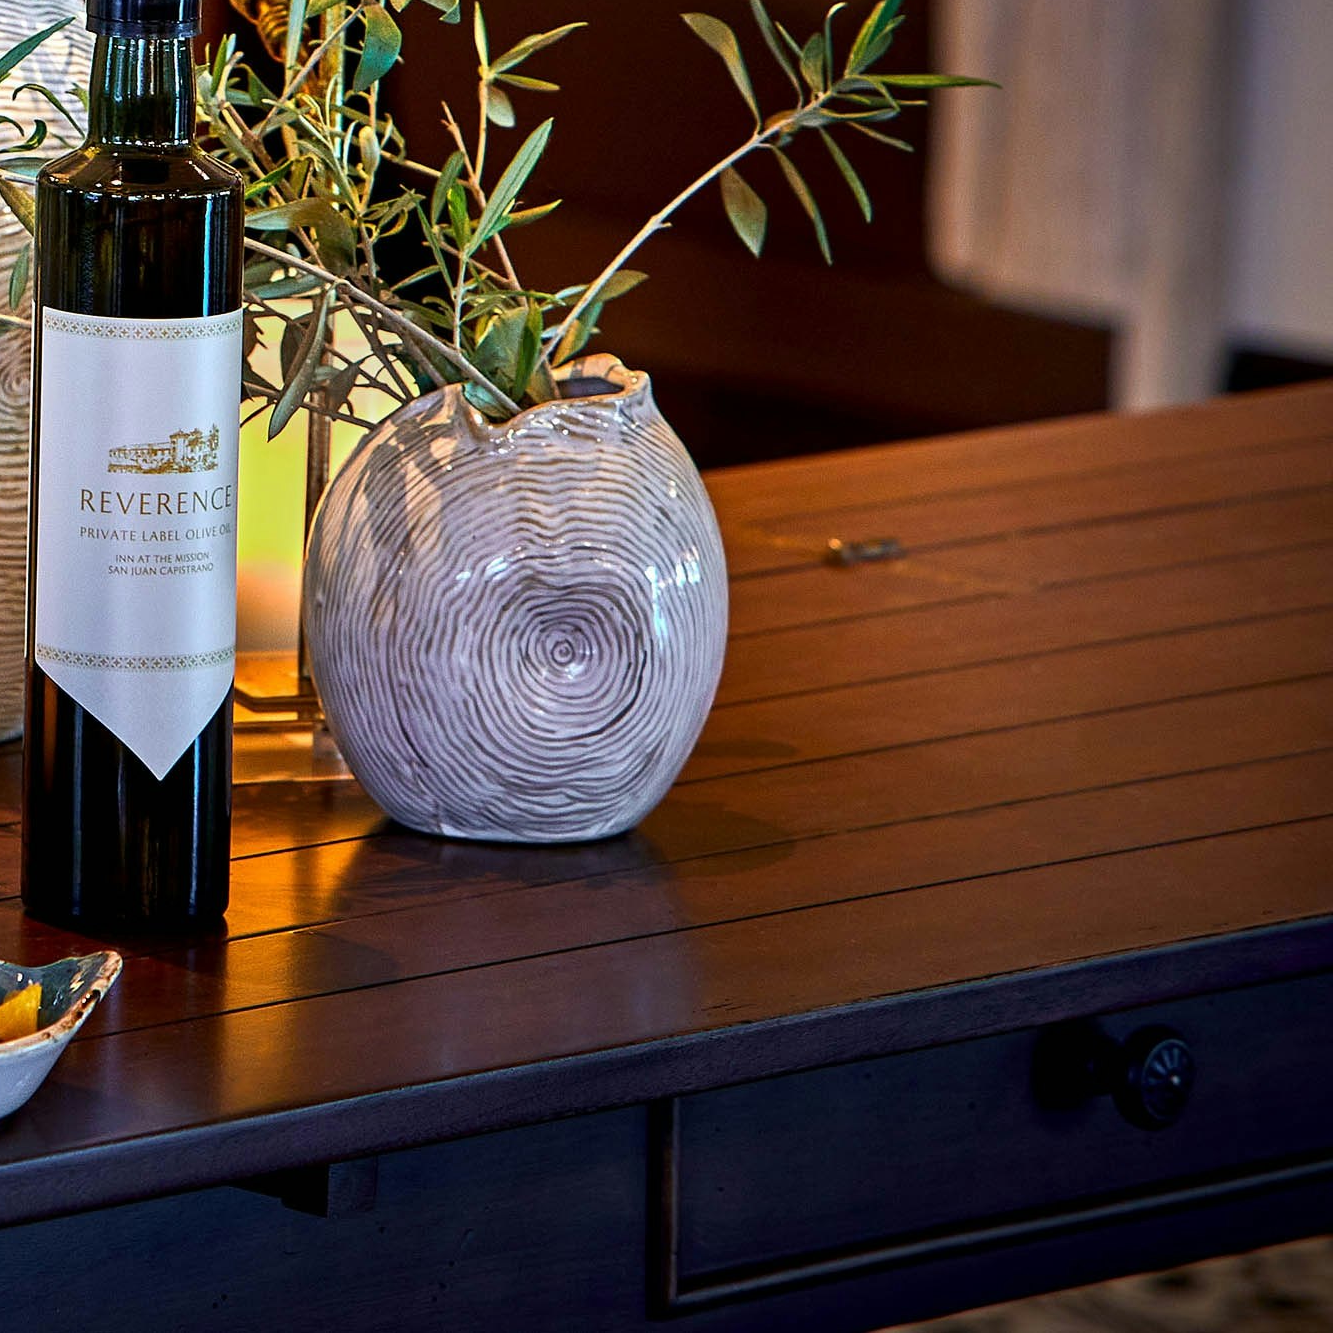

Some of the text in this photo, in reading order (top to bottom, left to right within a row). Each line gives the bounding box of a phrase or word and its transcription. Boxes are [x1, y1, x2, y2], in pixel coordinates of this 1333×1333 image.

[81, 485, 231, 515] REVERENCE
[80, 527, 136, 541] PRIVATE
[142, 531, 180, 542] LABEL
[186, 526, 216, 540] OLIVE
[116, 552, 209, 563] INN AT THE MISSION
[108, 563, 213, 576] SAN JUAN CAPISTRANO
